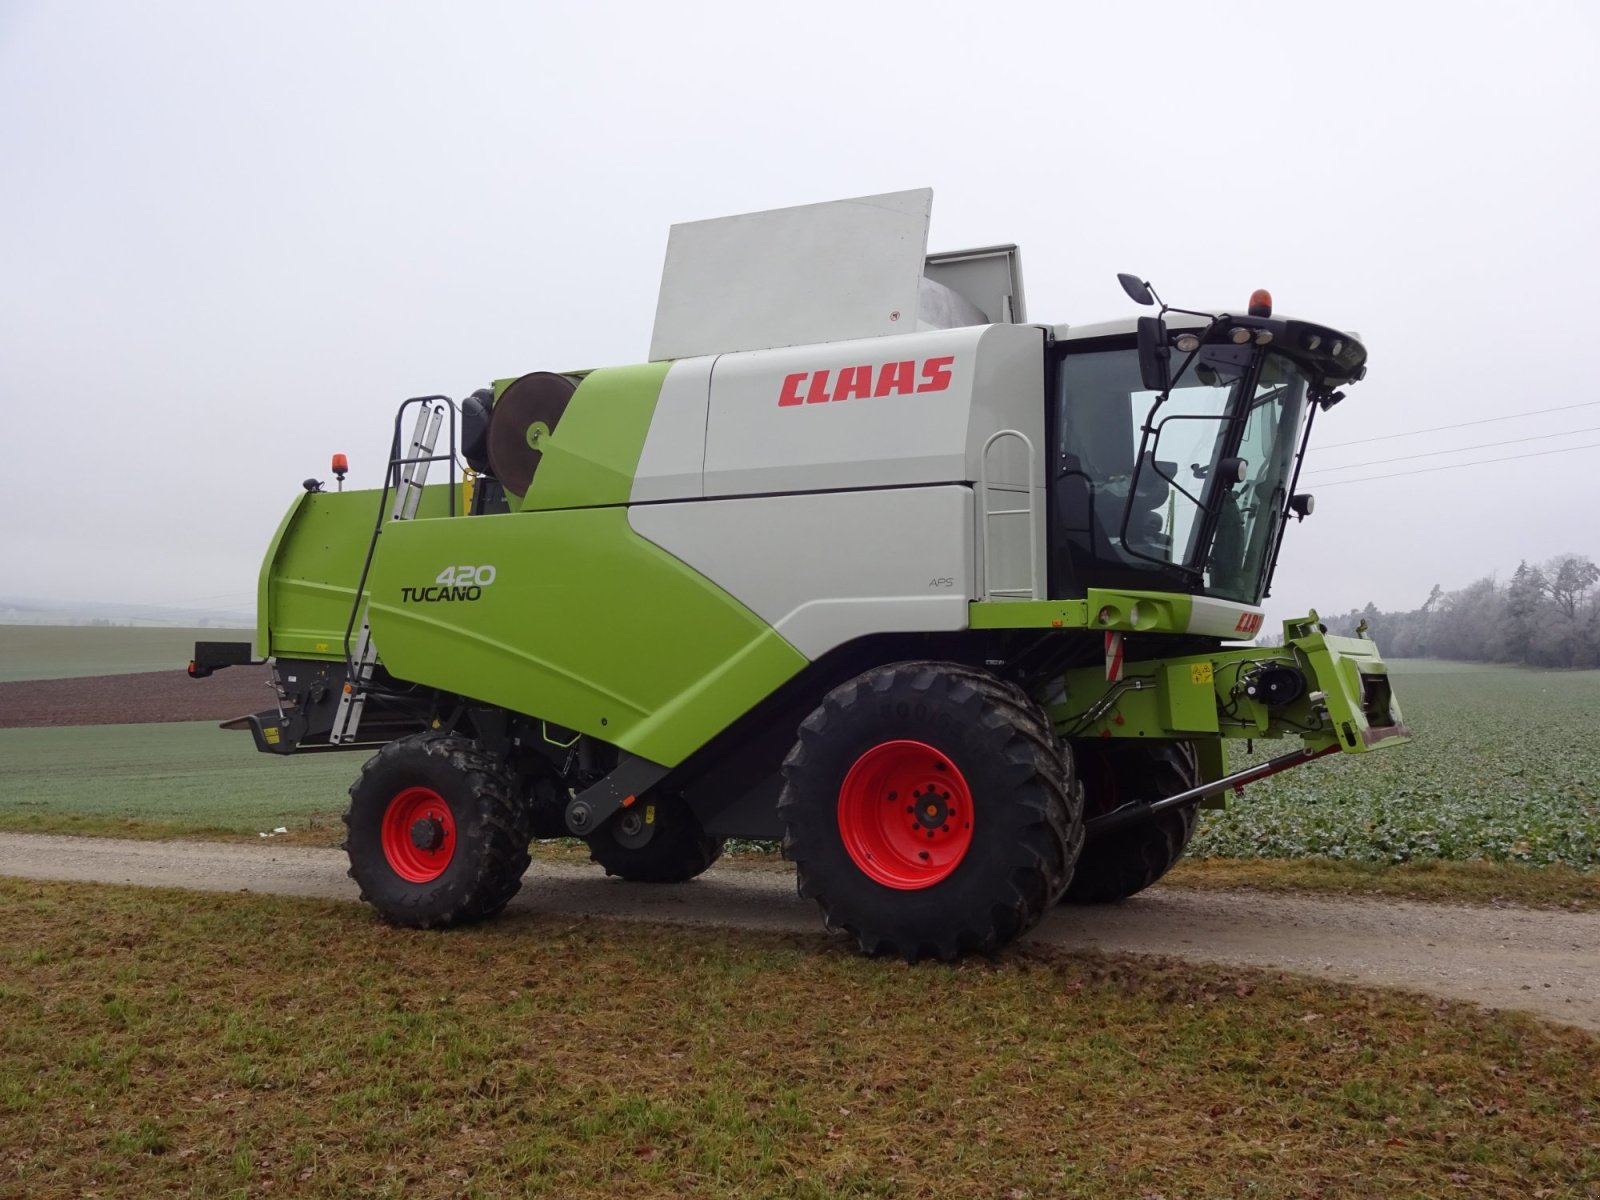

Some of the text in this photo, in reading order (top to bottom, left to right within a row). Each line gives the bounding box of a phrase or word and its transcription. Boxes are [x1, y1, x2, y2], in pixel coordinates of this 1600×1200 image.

[777, 355, 955, 407] CLAAS
[436, 565, 497, 587] 420
[928, 577, 955, 588] APS
[401, 585, 482, 603] TUCANO
